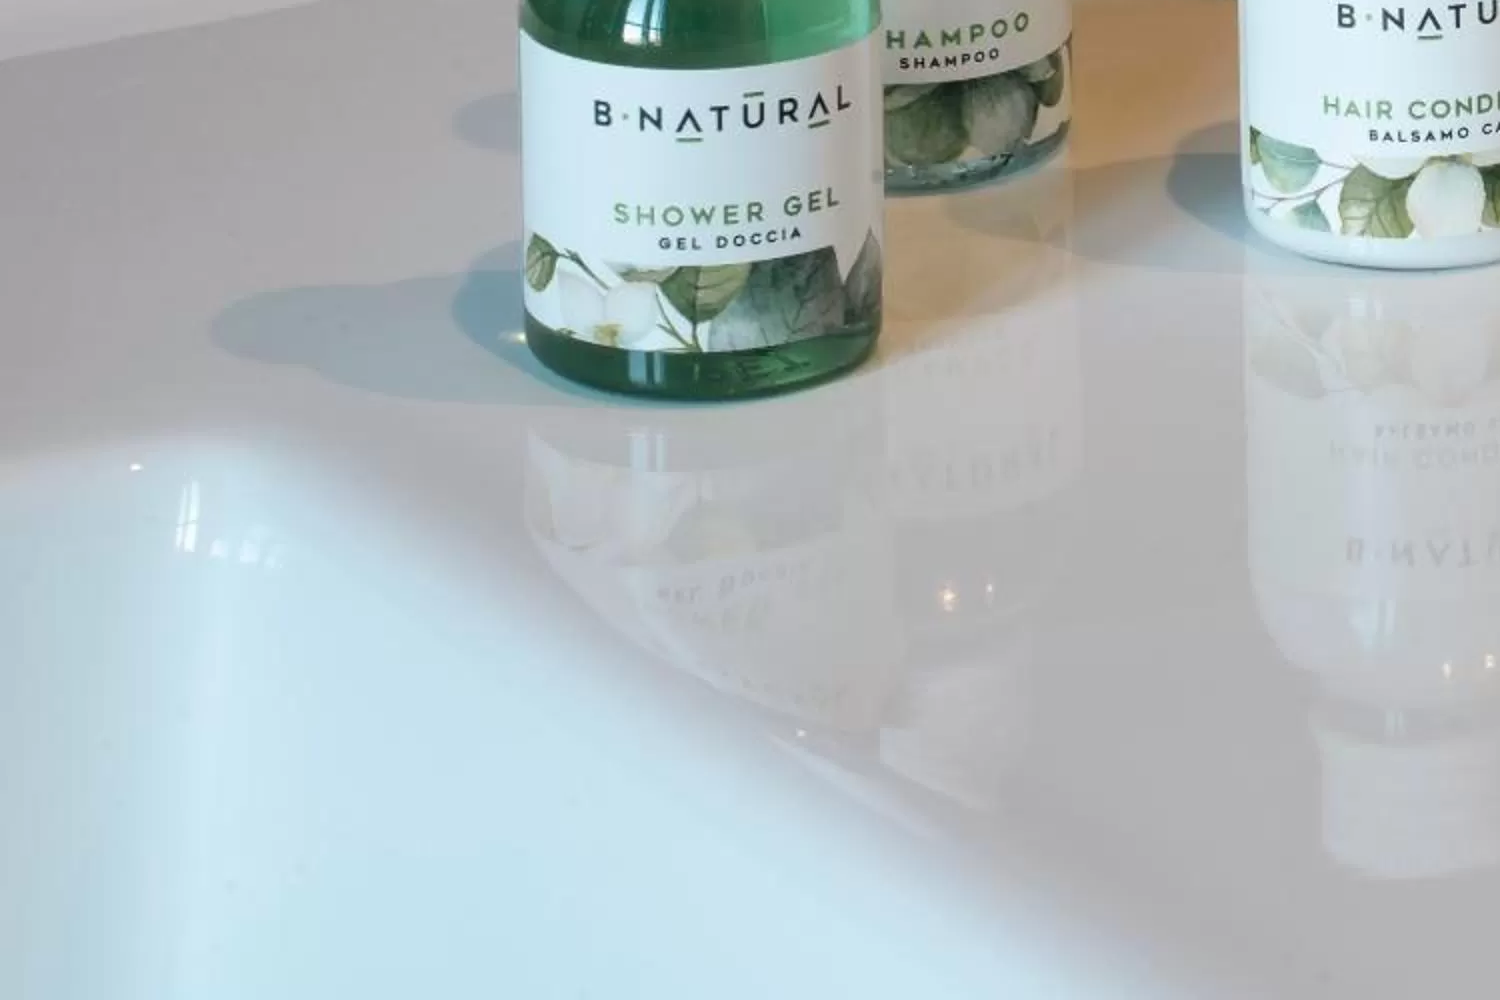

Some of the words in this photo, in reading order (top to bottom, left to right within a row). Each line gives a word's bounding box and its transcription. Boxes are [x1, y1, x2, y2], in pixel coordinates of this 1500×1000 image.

[885, 11, 1030, 50] HAMPOO
[899, 47, 1000, 70] SHAMPOO
[1323, 94, 1394, 121] HAIR
[1368, 126, 1470, 144] BALSAMO
[613, 201, 766, 228] SHOWER
[783, 186, 841, 218] GEL
[658, 236, 702, 251] GEL
[715, 226, 802, 250] DOCCIA
